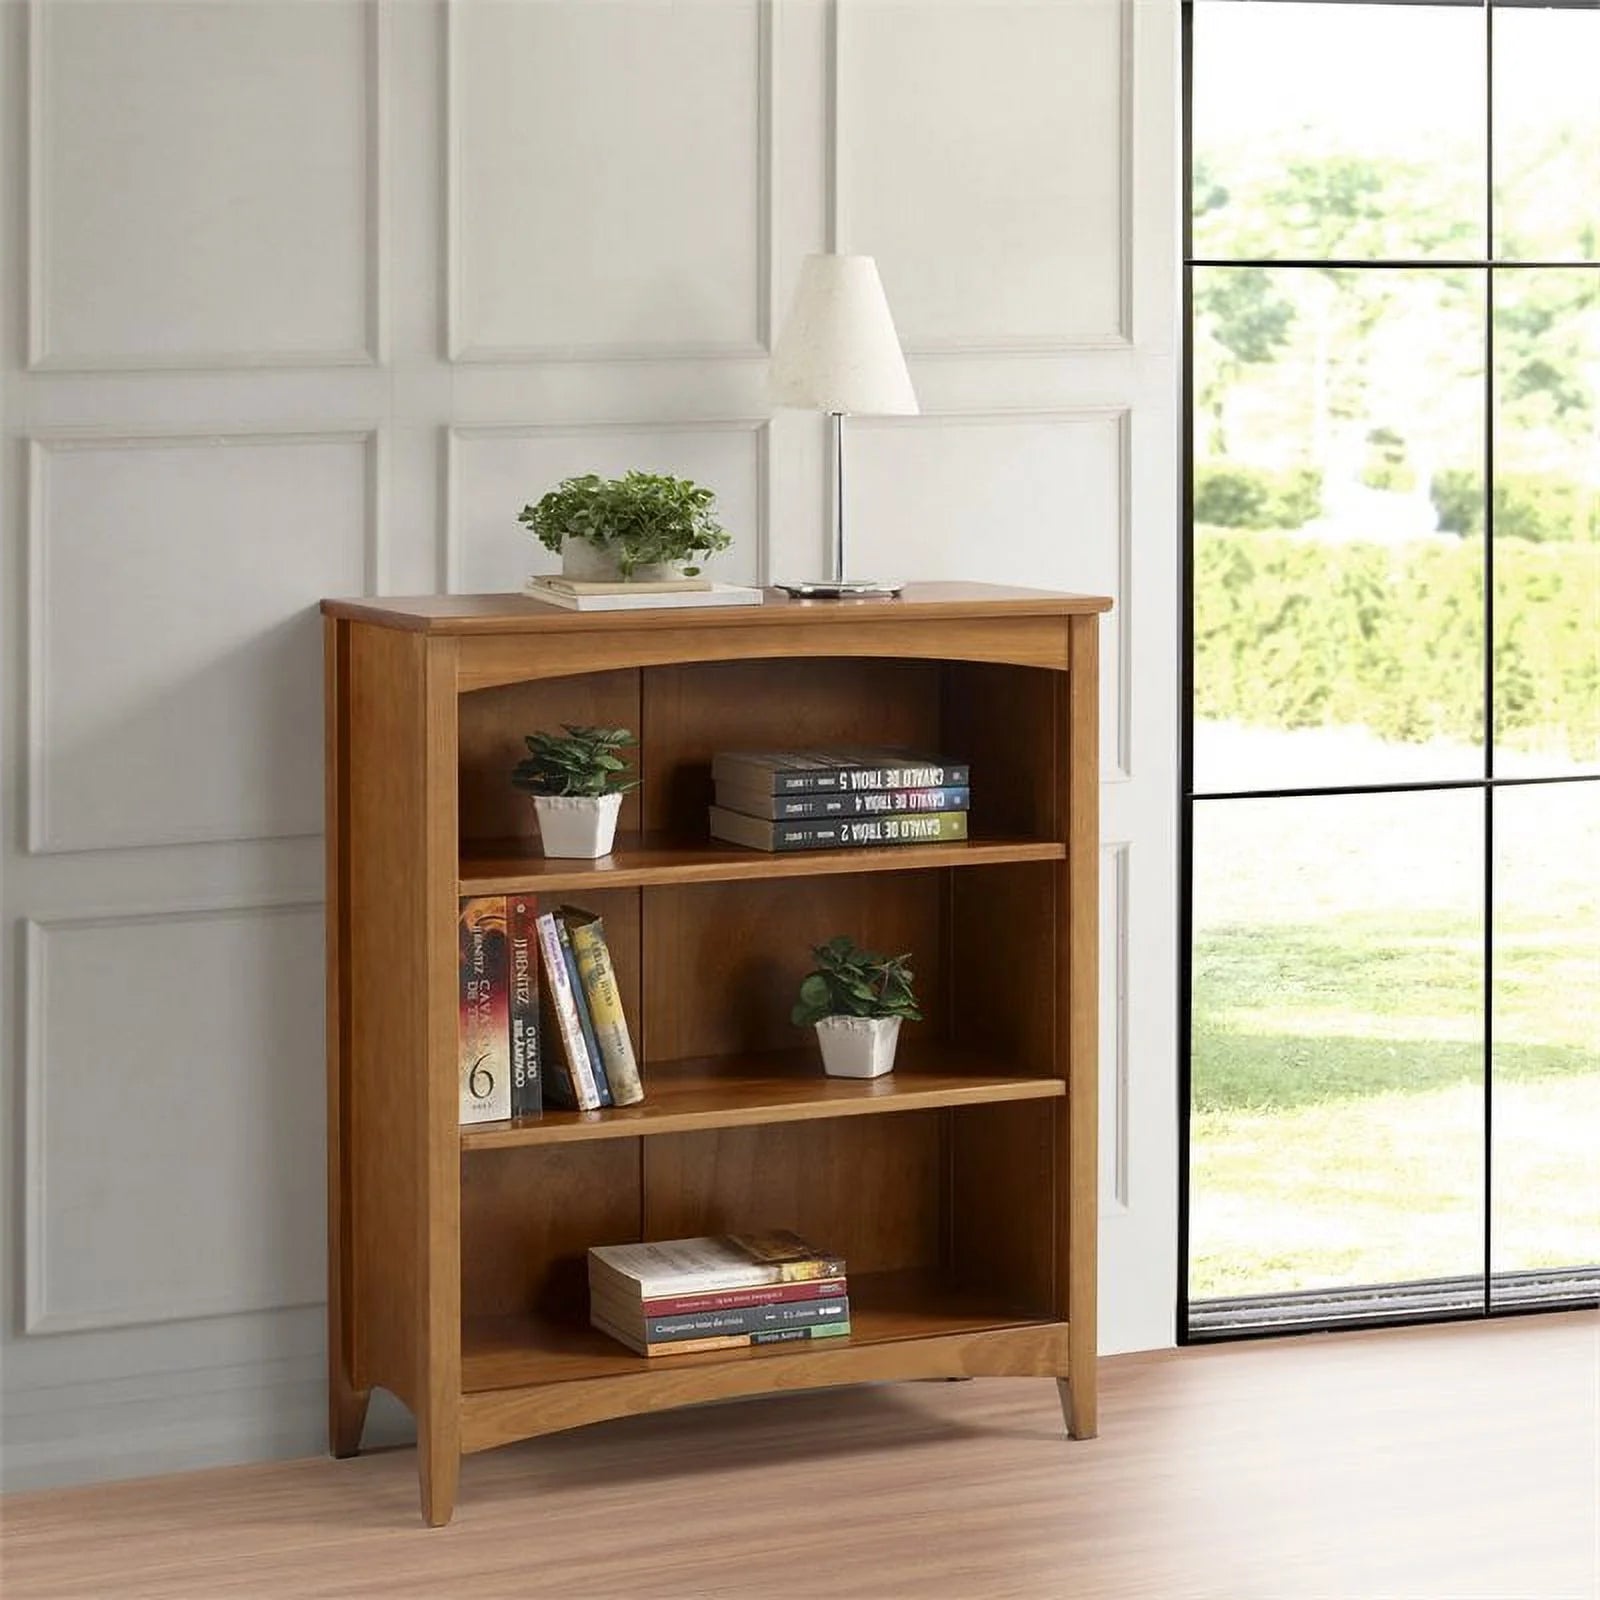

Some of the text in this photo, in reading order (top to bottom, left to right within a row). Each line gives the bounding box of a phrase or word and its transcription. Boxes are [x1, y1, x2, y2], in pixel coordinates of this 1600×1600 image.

[840, 772, 848, 790] 5
[903, 768, 944, 786] CAVALO
[855, 795, 862, 812] 4
[909, 791, 945, 807] CAVALO
[841, 824, 849, 841] 2
[901, 819, 941, 837] CAVALO
[469, 1052, 495, 1099] 6
